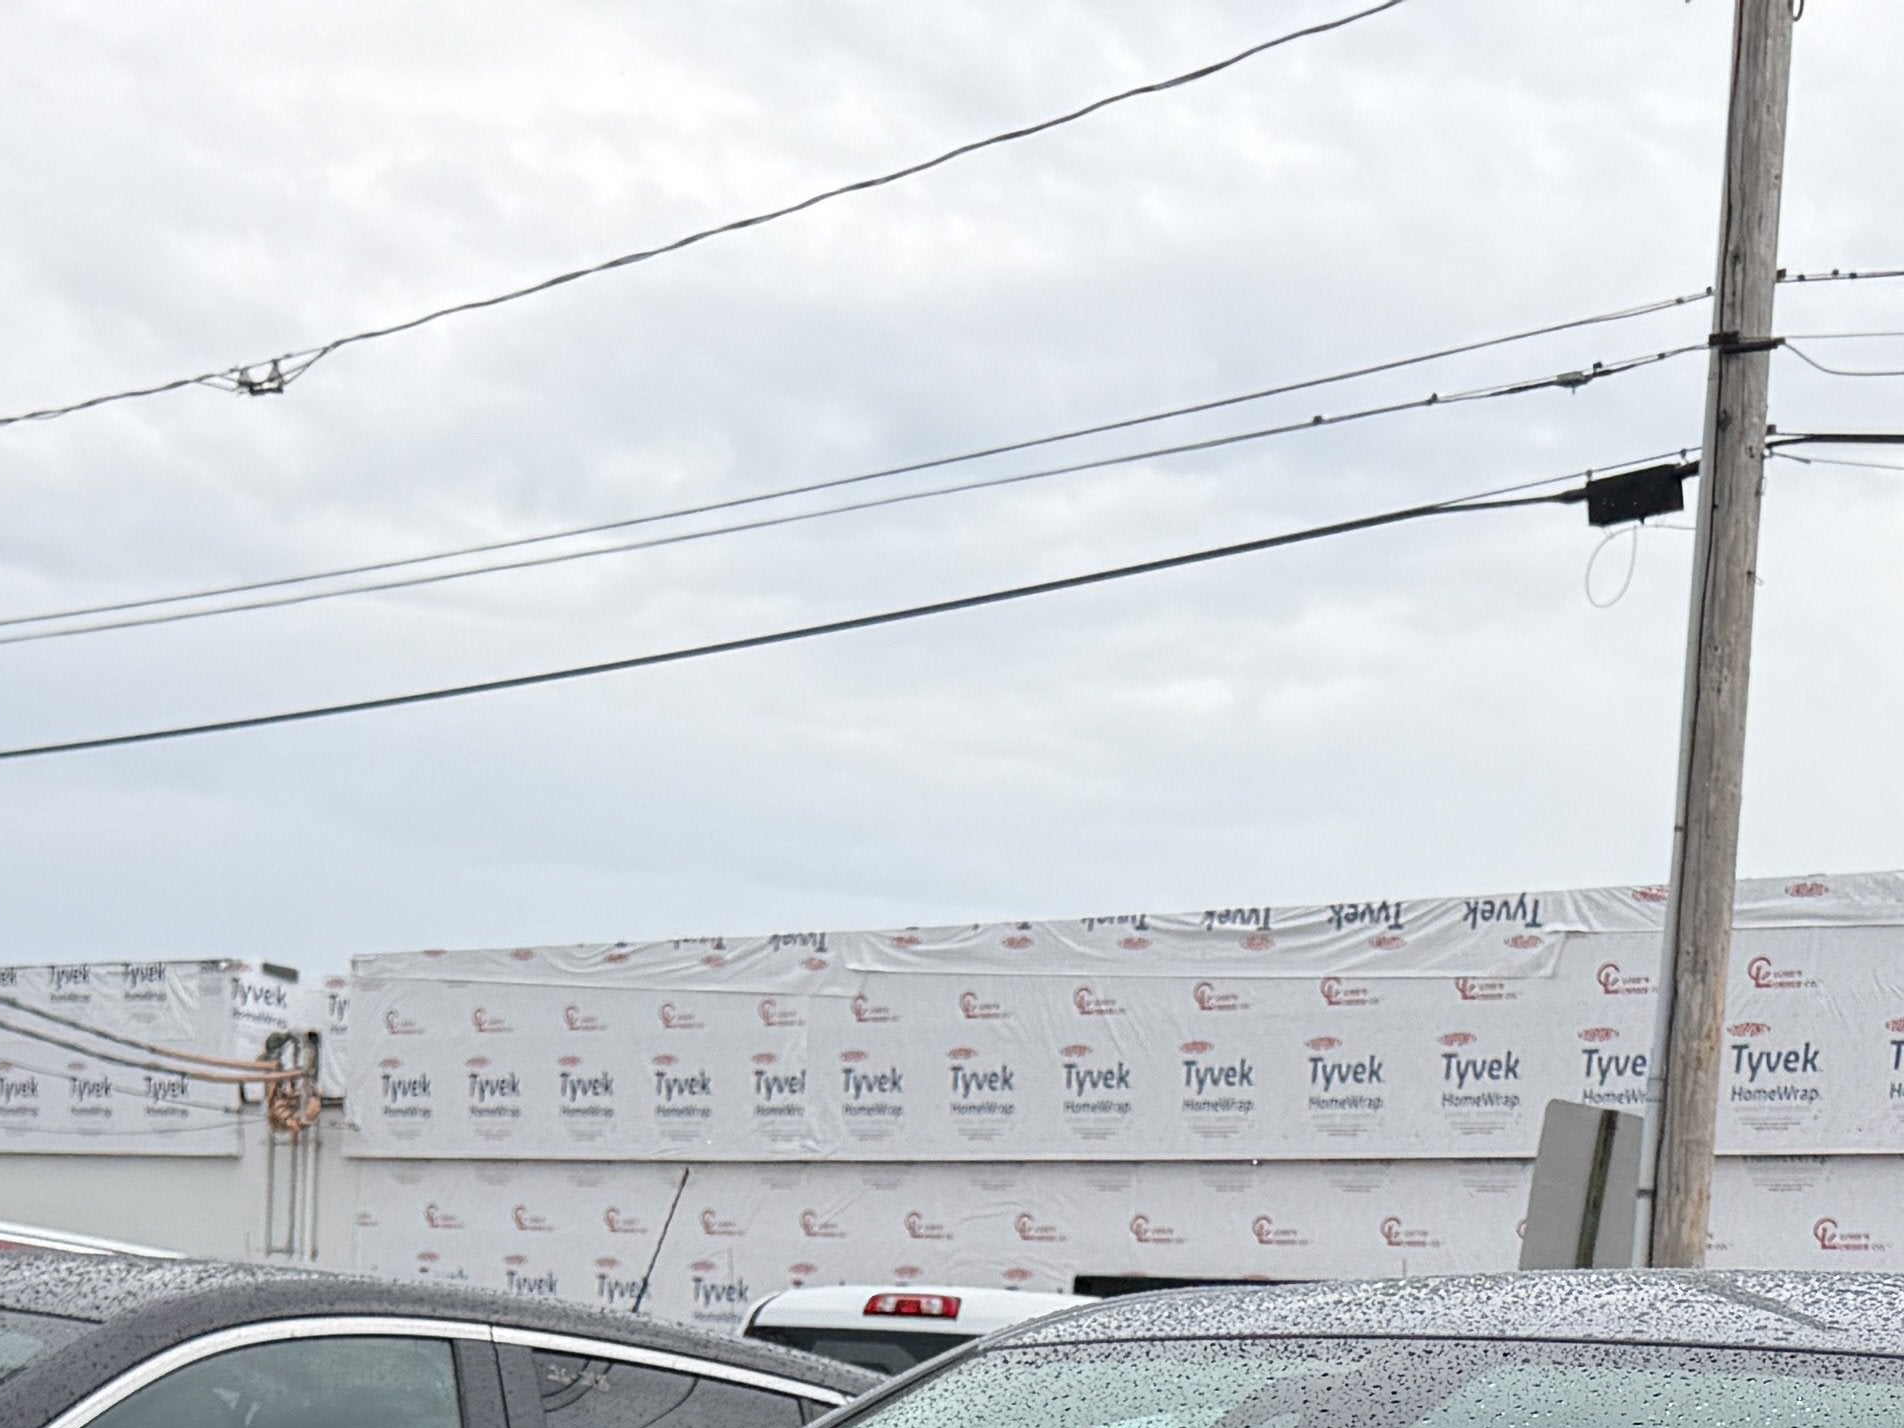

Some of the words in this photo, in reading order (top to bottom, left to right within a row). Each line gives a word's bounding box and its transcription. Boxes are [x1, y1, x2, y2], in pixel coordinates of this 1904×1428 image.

[231, 976, 287, 1008] Tyvek
[1063, 1062, 1130, 1097] Tyvek
[1182, 1058, 1253, 1095] Tyvek
[1309, 1055, 1382, 1092] Tyvek
[1441, 1050, 1519, 1089] Tyvek
[1582, 1048, 1647, 1088] Tyve
[1732, 1042, 1819, 1083] Tyvek
[842, 1067, 903, 1100] Tyvek
[950, 1065, 1014, 1099] Tyvek
[1732, 1085, 1819, 1104] HomeWrap
[1441, 1093, 1520, 1111] HomeWrap
